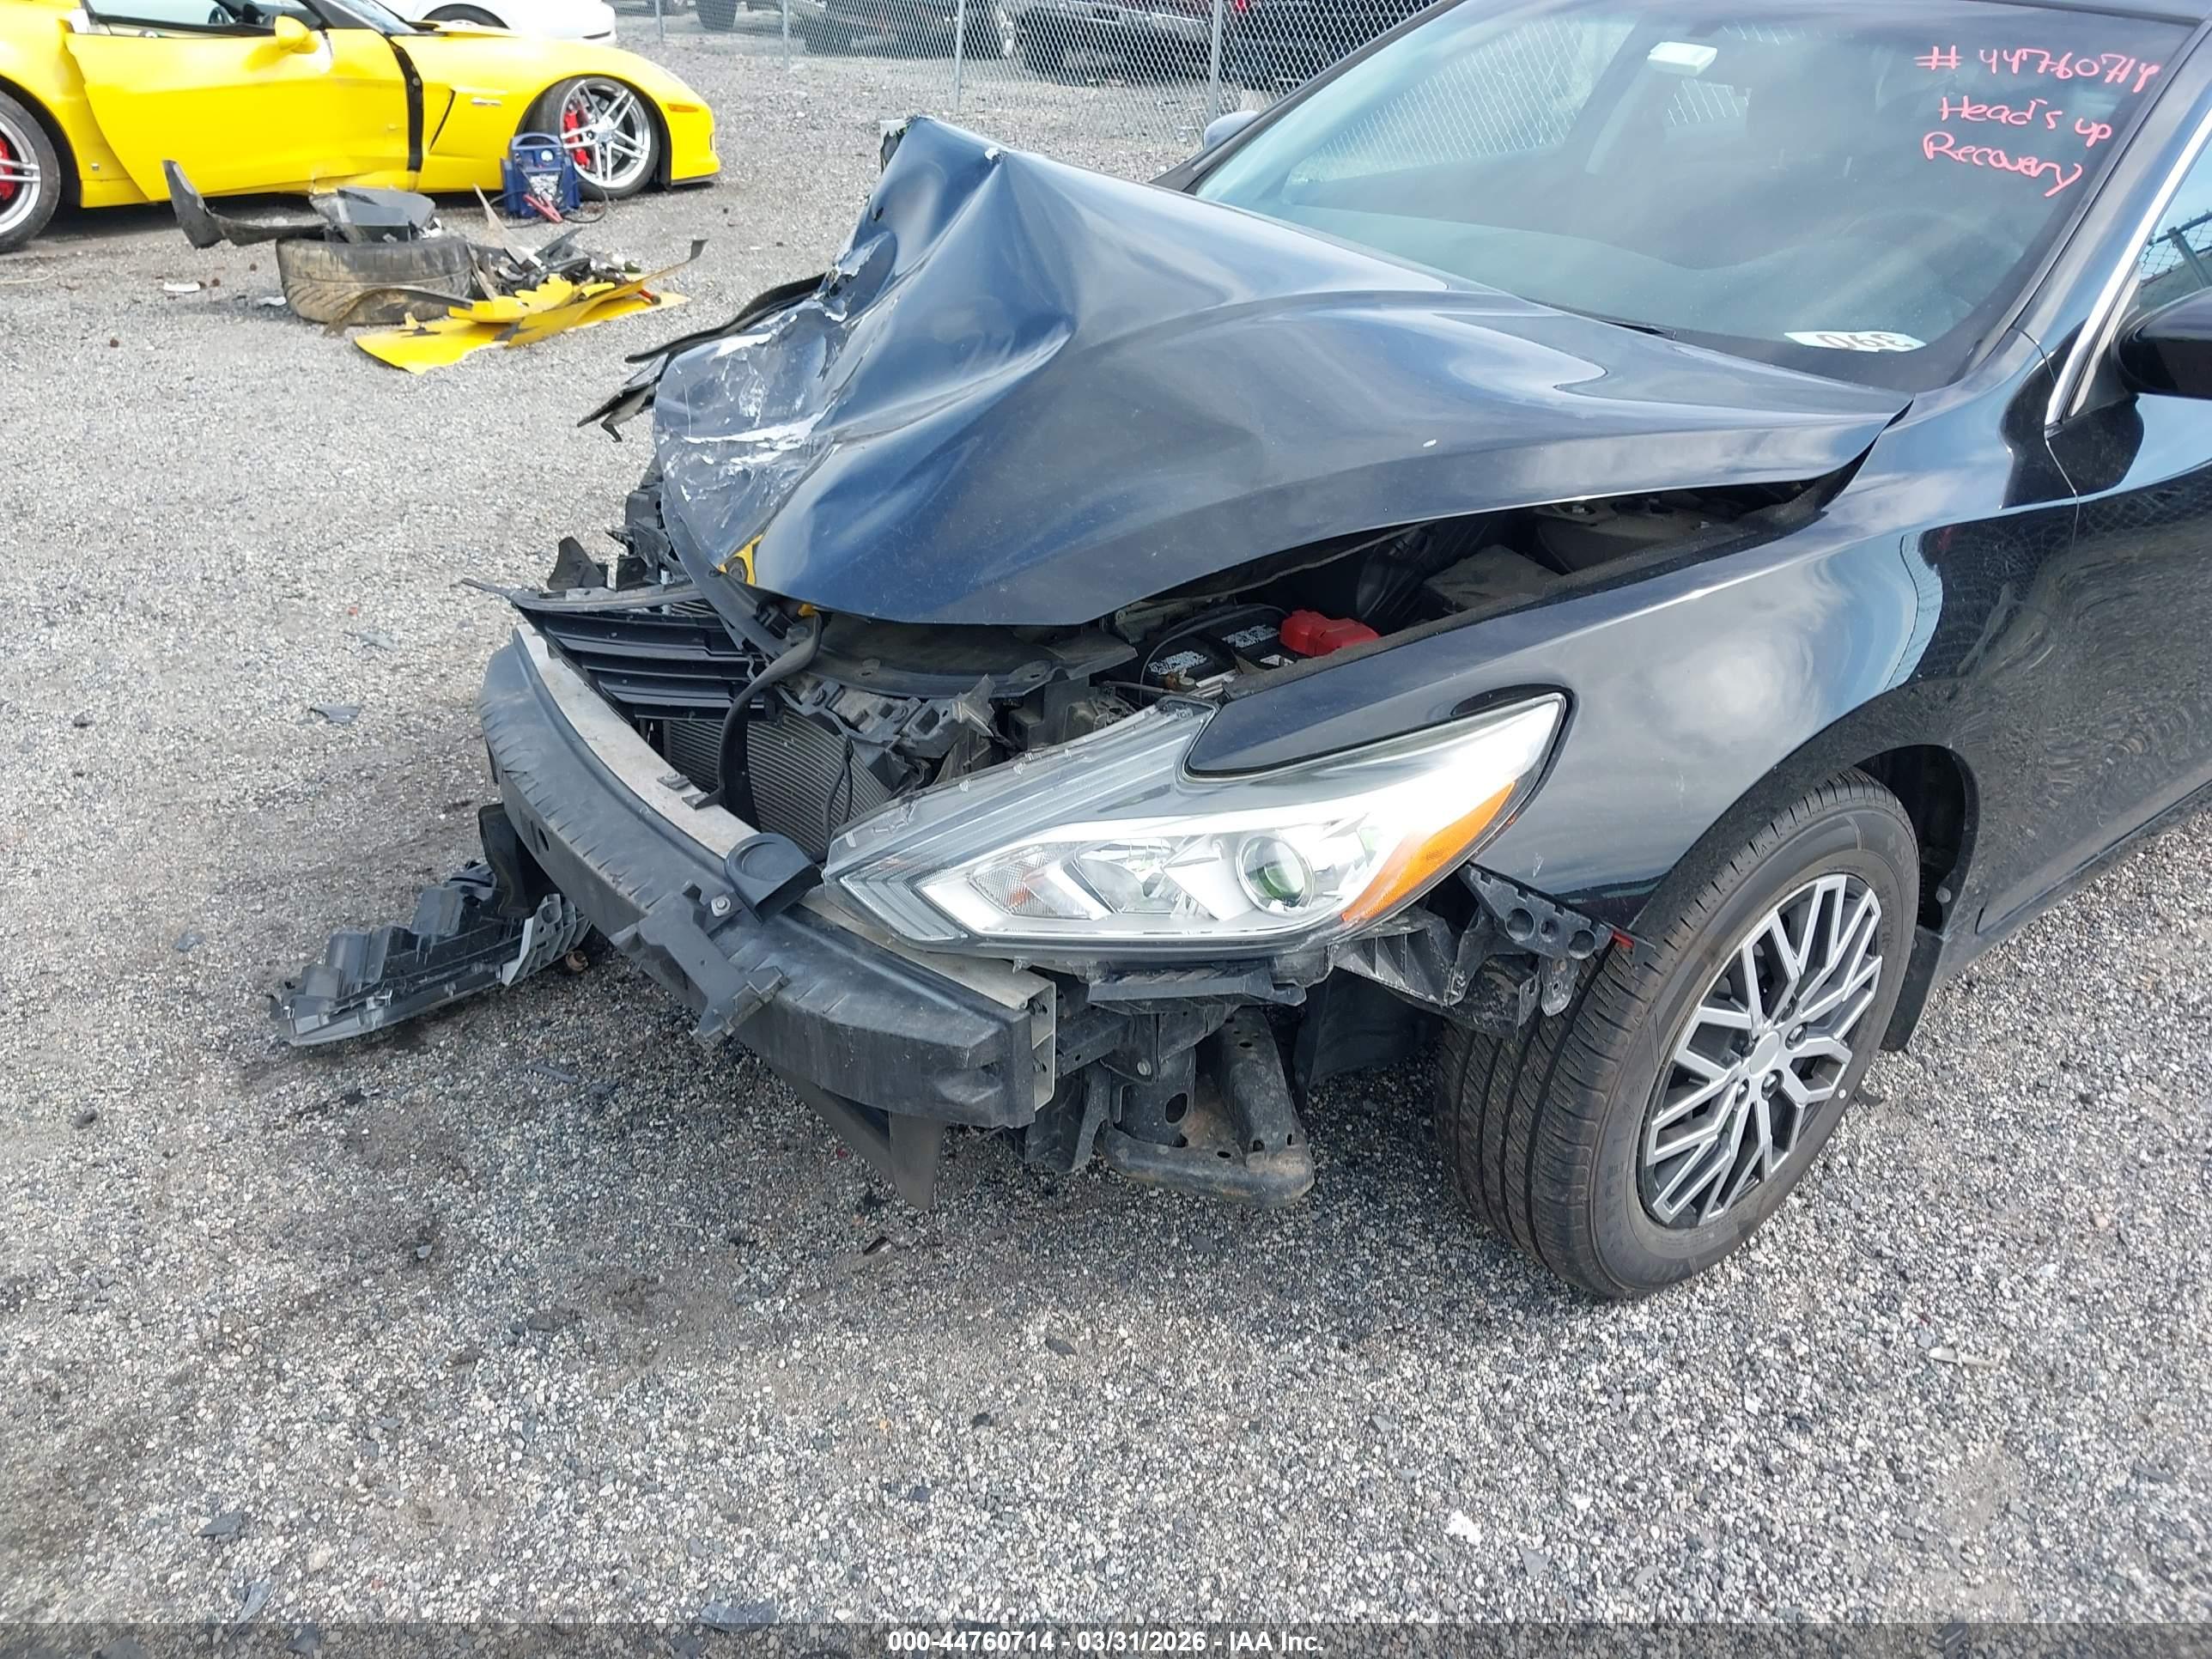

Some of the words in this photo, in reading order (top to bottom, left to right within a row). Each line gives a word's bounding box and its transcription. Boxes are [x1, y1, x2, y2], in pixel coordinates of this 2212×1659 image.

[1914, 45, 1963, 70] #
[1979, 47, 2160, 93] 44760714
[1938, 94, 2063, 130] Head's
[2075, 118, 2112, 148] up
[1923, 131, 2083, 197] Recovery
